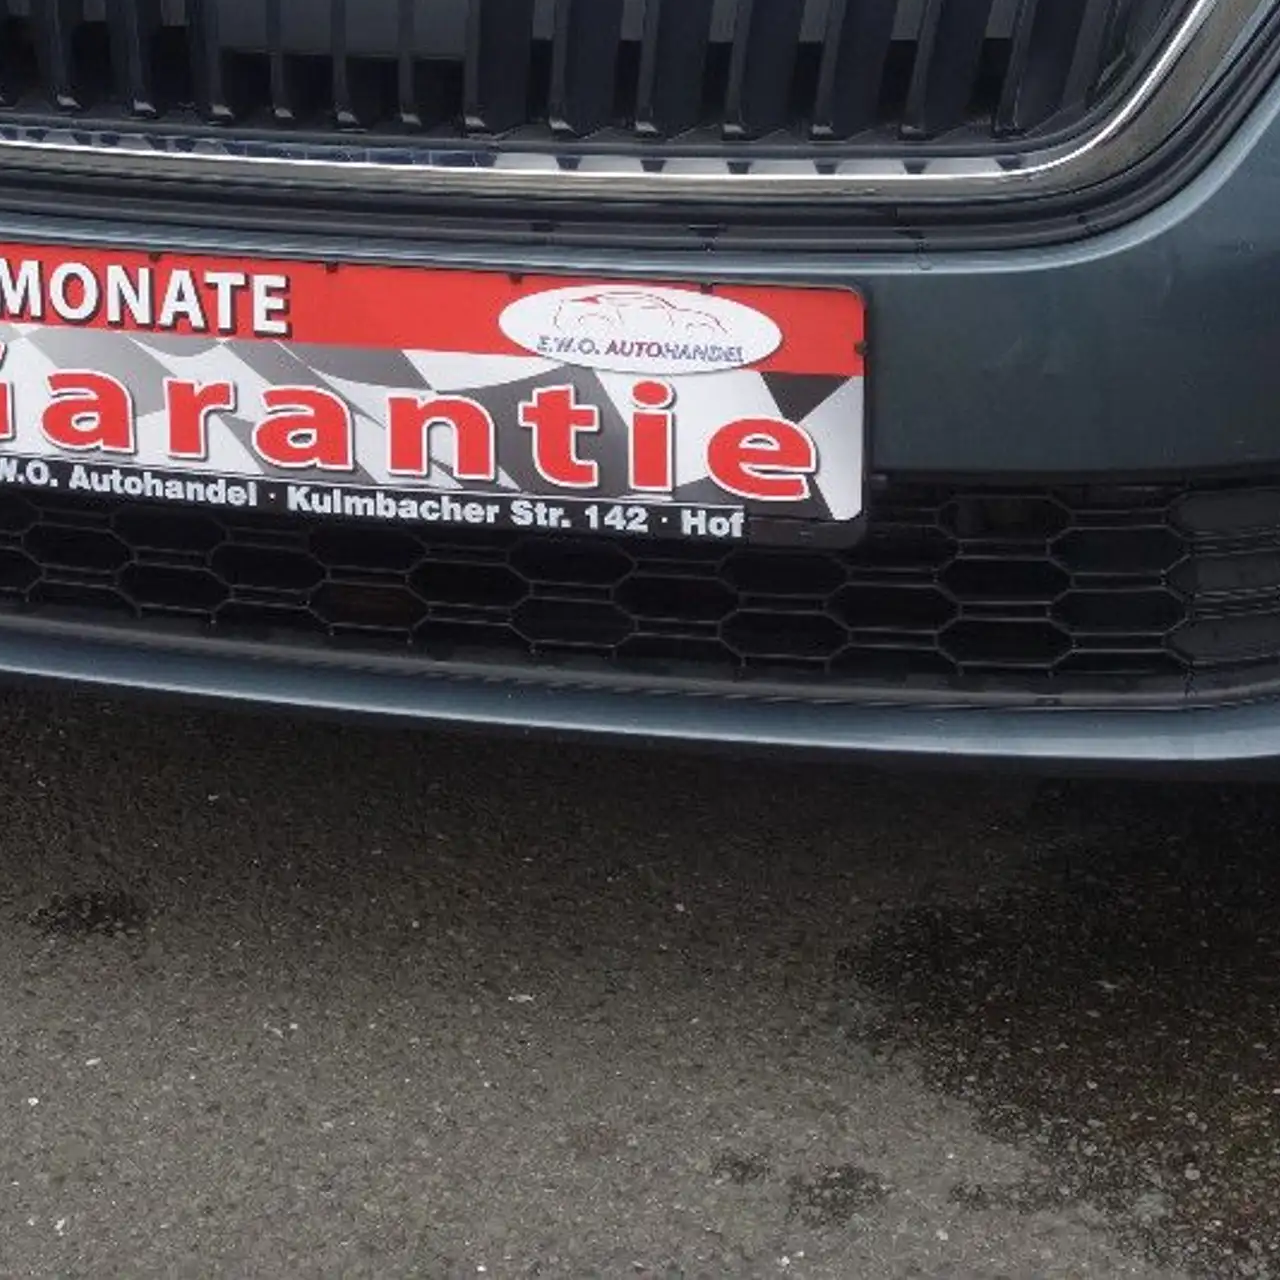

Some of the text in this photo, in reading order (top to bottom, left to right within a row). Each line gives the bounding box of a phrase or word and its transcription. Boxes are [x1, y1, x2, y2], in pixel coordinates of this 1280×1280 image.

[536, 335, 745, 363] E.W.O. AUTOHANDEL
[68, 464, 258, 508] Autohandel
[287, 487, 499, 525] Kulmbacher
[510, 500, 571, 529] Str.
[584, 505, 650, 534] 142
[681, 508, 745, 538] Hof
